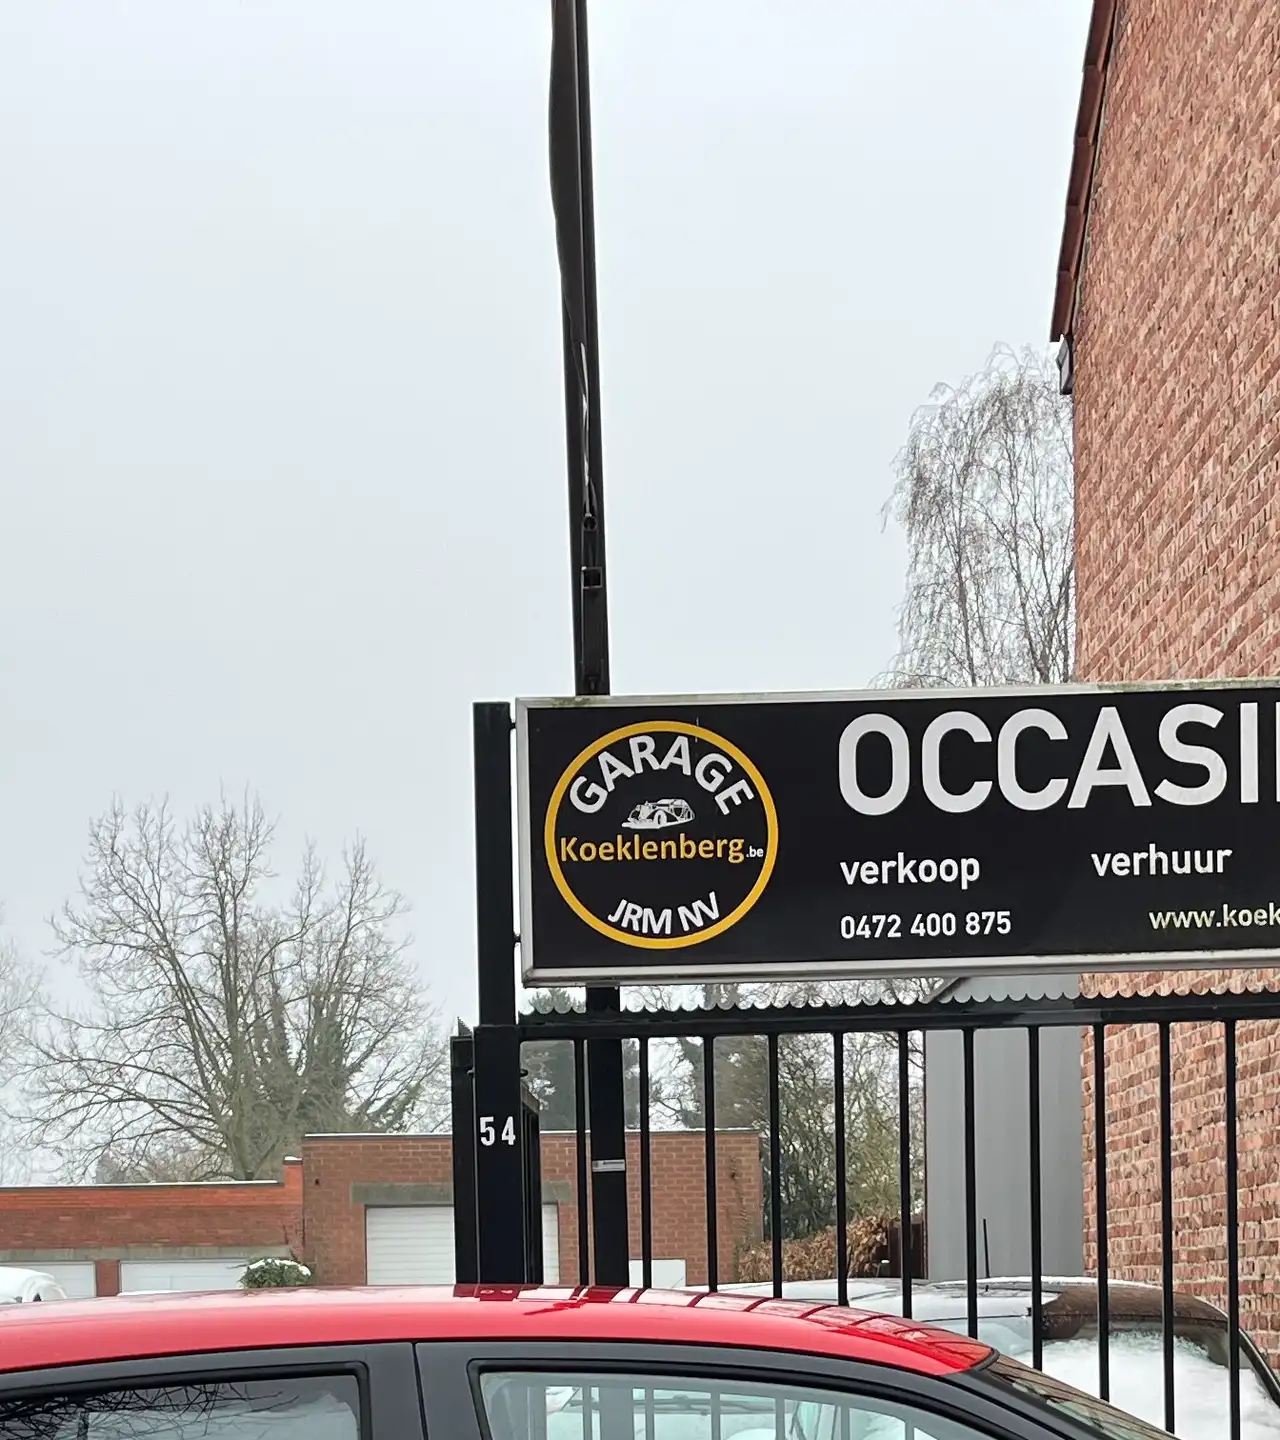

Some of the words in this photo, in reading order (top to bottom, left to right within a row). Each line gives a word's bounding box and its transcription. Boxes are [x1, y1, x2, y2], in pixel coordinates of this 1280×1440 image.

[569, 734, 755, 816] GARAGE
[560, 833, 765, 864] Koeklenberg.be
[1090, 843, 1233, 877] verhuur
[840, 851, 981, 890] verkoop
[607, 899, 672, 935] JRM
[677, 891, 721, 932] NV
[840, 914, 902, 940] 0472
[910, 912, 957, 937] 400
[965, 910, 1012, 936] 875
[479, 1115, 516, 1147] 54
